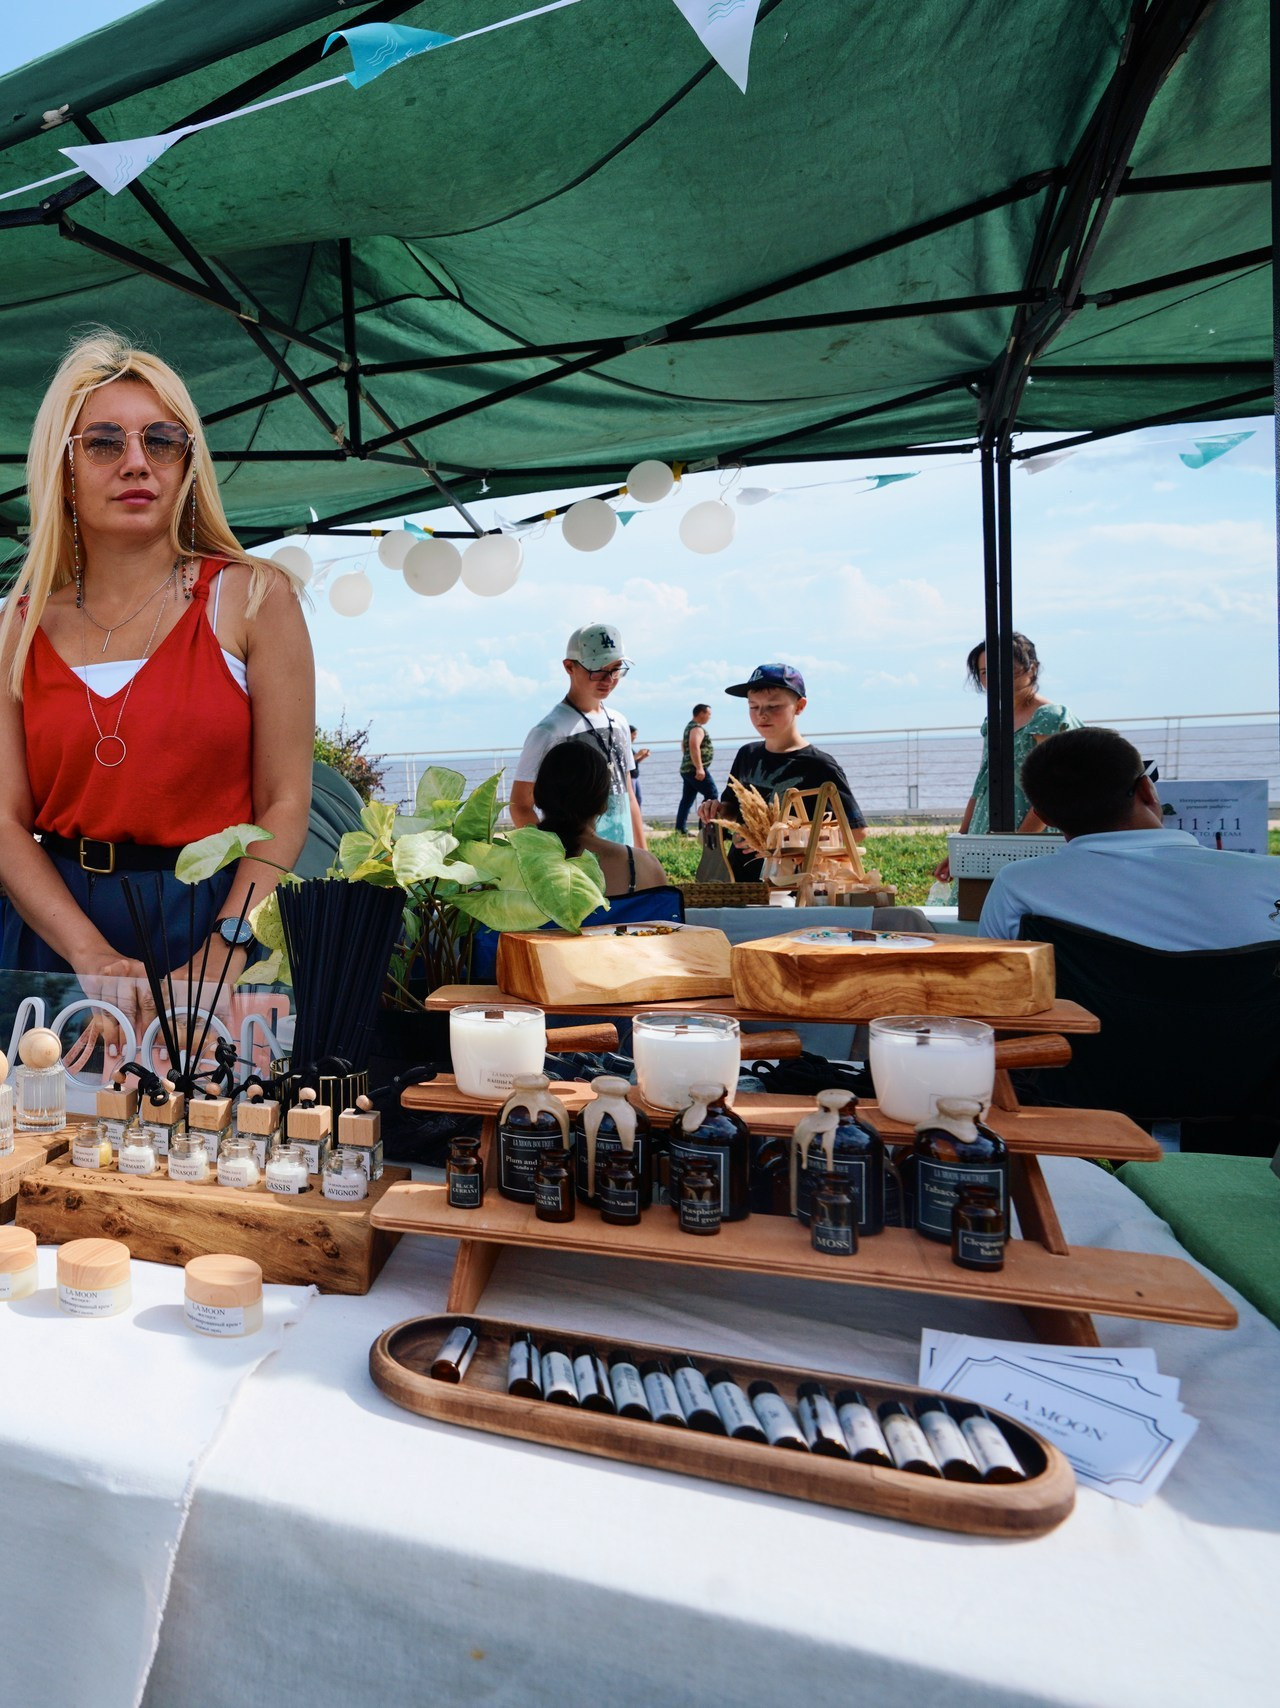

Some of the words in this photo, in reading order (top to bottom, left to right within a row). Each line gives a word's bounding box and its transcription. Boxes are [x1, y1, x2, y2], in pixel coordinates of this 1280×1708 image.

[599, 632, 616, 648] LA
[505, 1155, 523, 1165] Plum
[523, 1158, 538, 1166] and
[79, 1172, 129, 1185] MOON
[327, 1187, 359, 1196] AVIGNON
[685, 1215, 700, 1223] and
[816, 1236, 850, 1249] MOSS
[75, 1291, 98, 1299] MOON
[202, 1307, 226, 1316] MOON
[1003, 1392, 1030, 1412] LA
[1033, 1403, 1109, 1443] MOON
